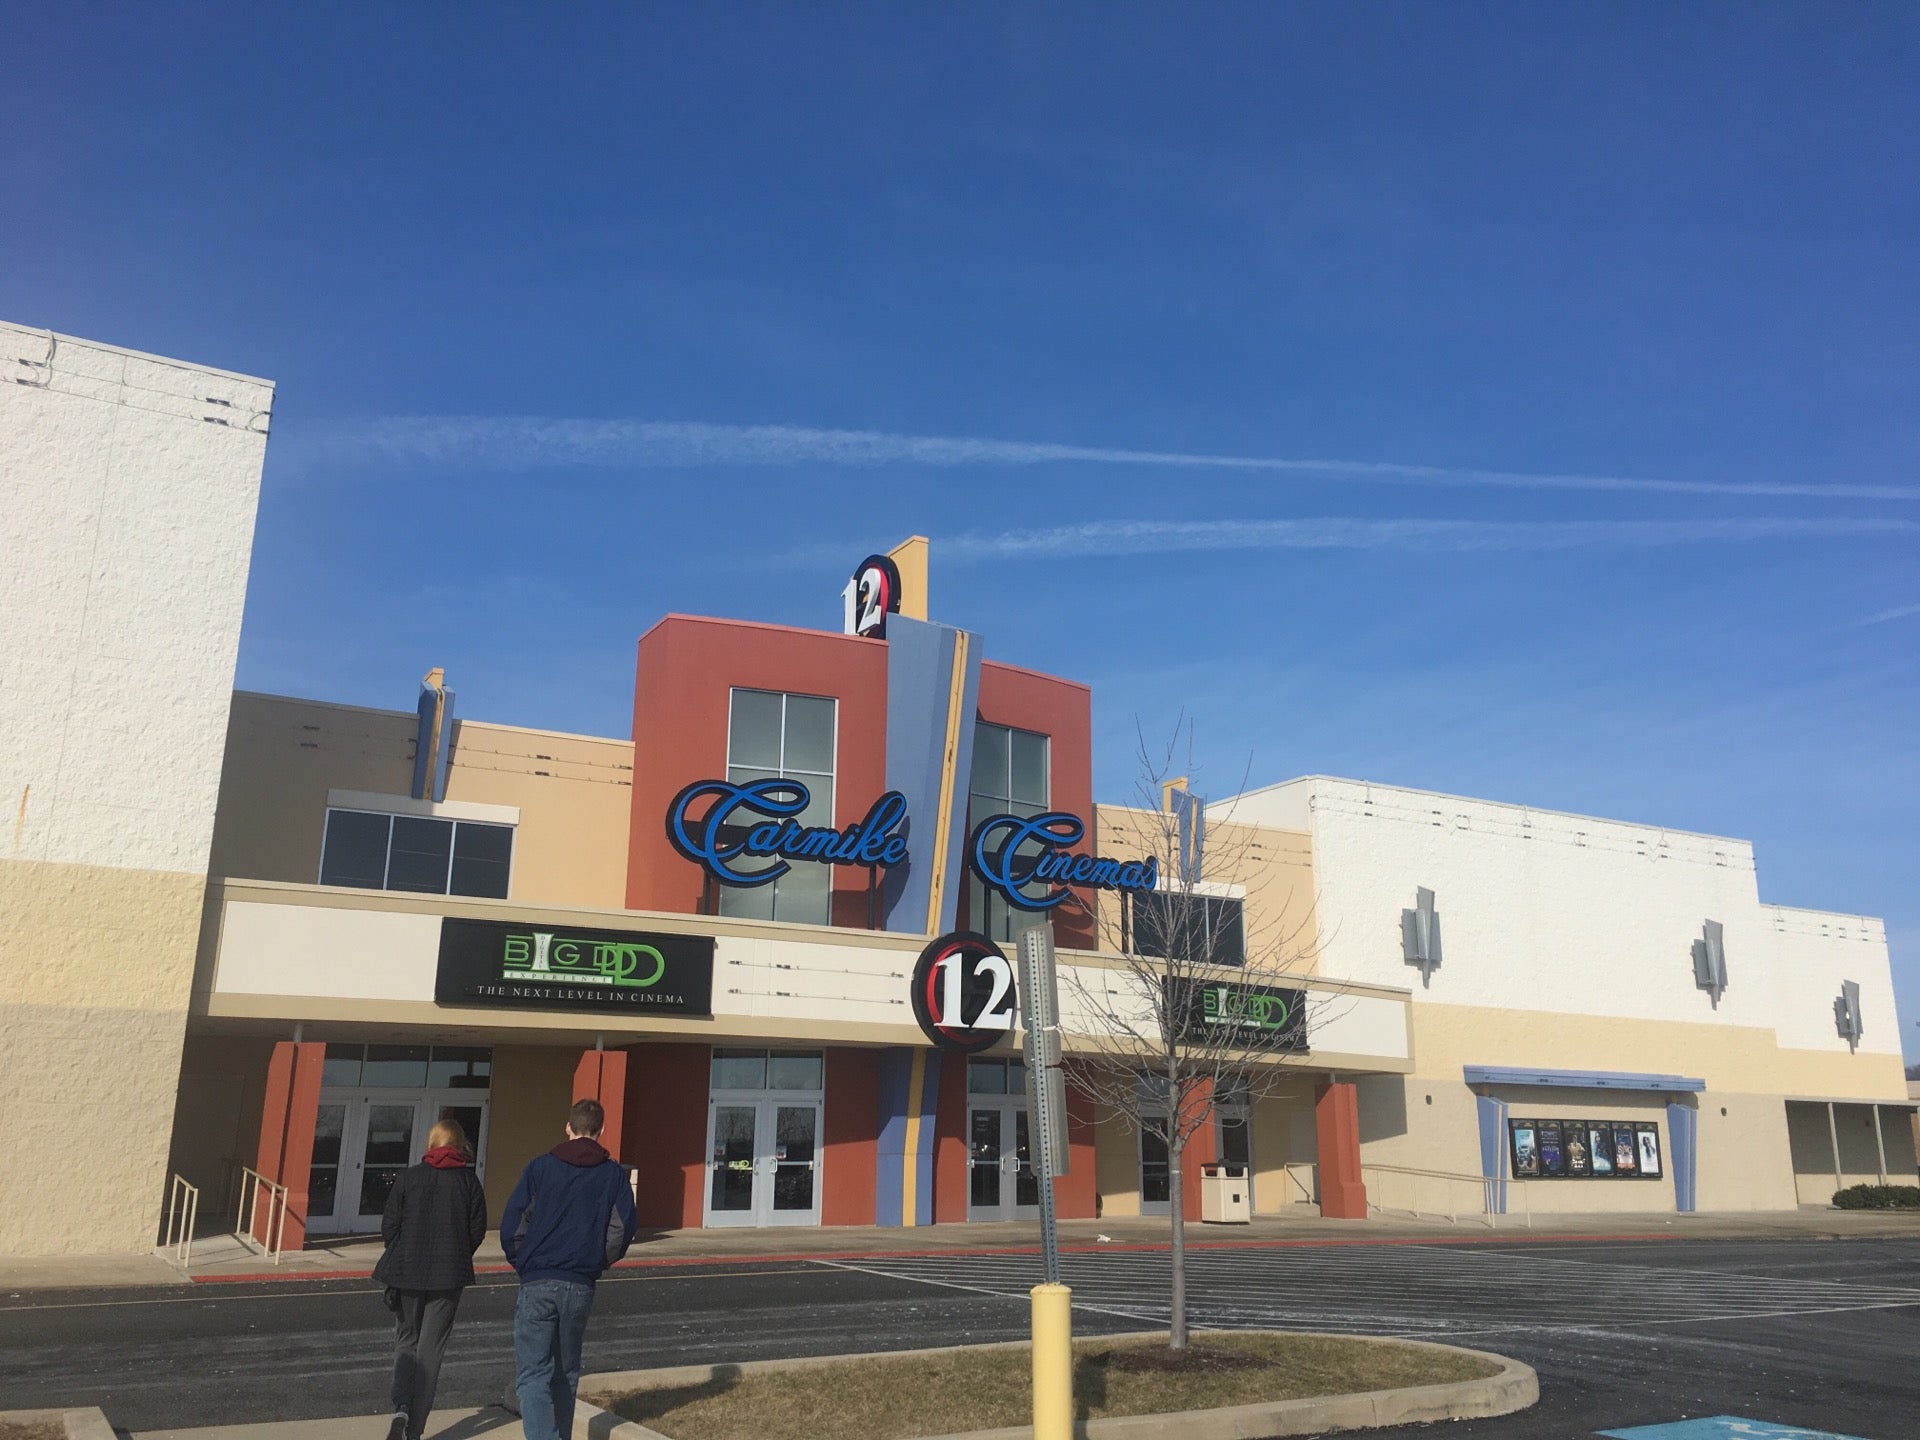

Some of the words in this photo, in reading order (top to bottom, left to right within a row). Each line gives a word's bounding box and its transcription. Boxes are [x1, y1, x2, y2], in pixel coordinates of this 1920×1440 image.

[841, 567, 882, 635] 12
[670, 779, 908, 886] Carmike
[972, 813, 1158, 910] Cinemas
[504, 932, 581, 971] BIG
[509, 971, 608, 983] EXPERIENCE
[477, 985, 505, 996] THE
[513, 987, 551, 999] NEXT
[558, 989, 603, 1001] LEVEL
[610, 991, 625, 1002] IN
[631, 992, 684, 1005] CINEMA
[934, 952, 1013, 1030] 12
